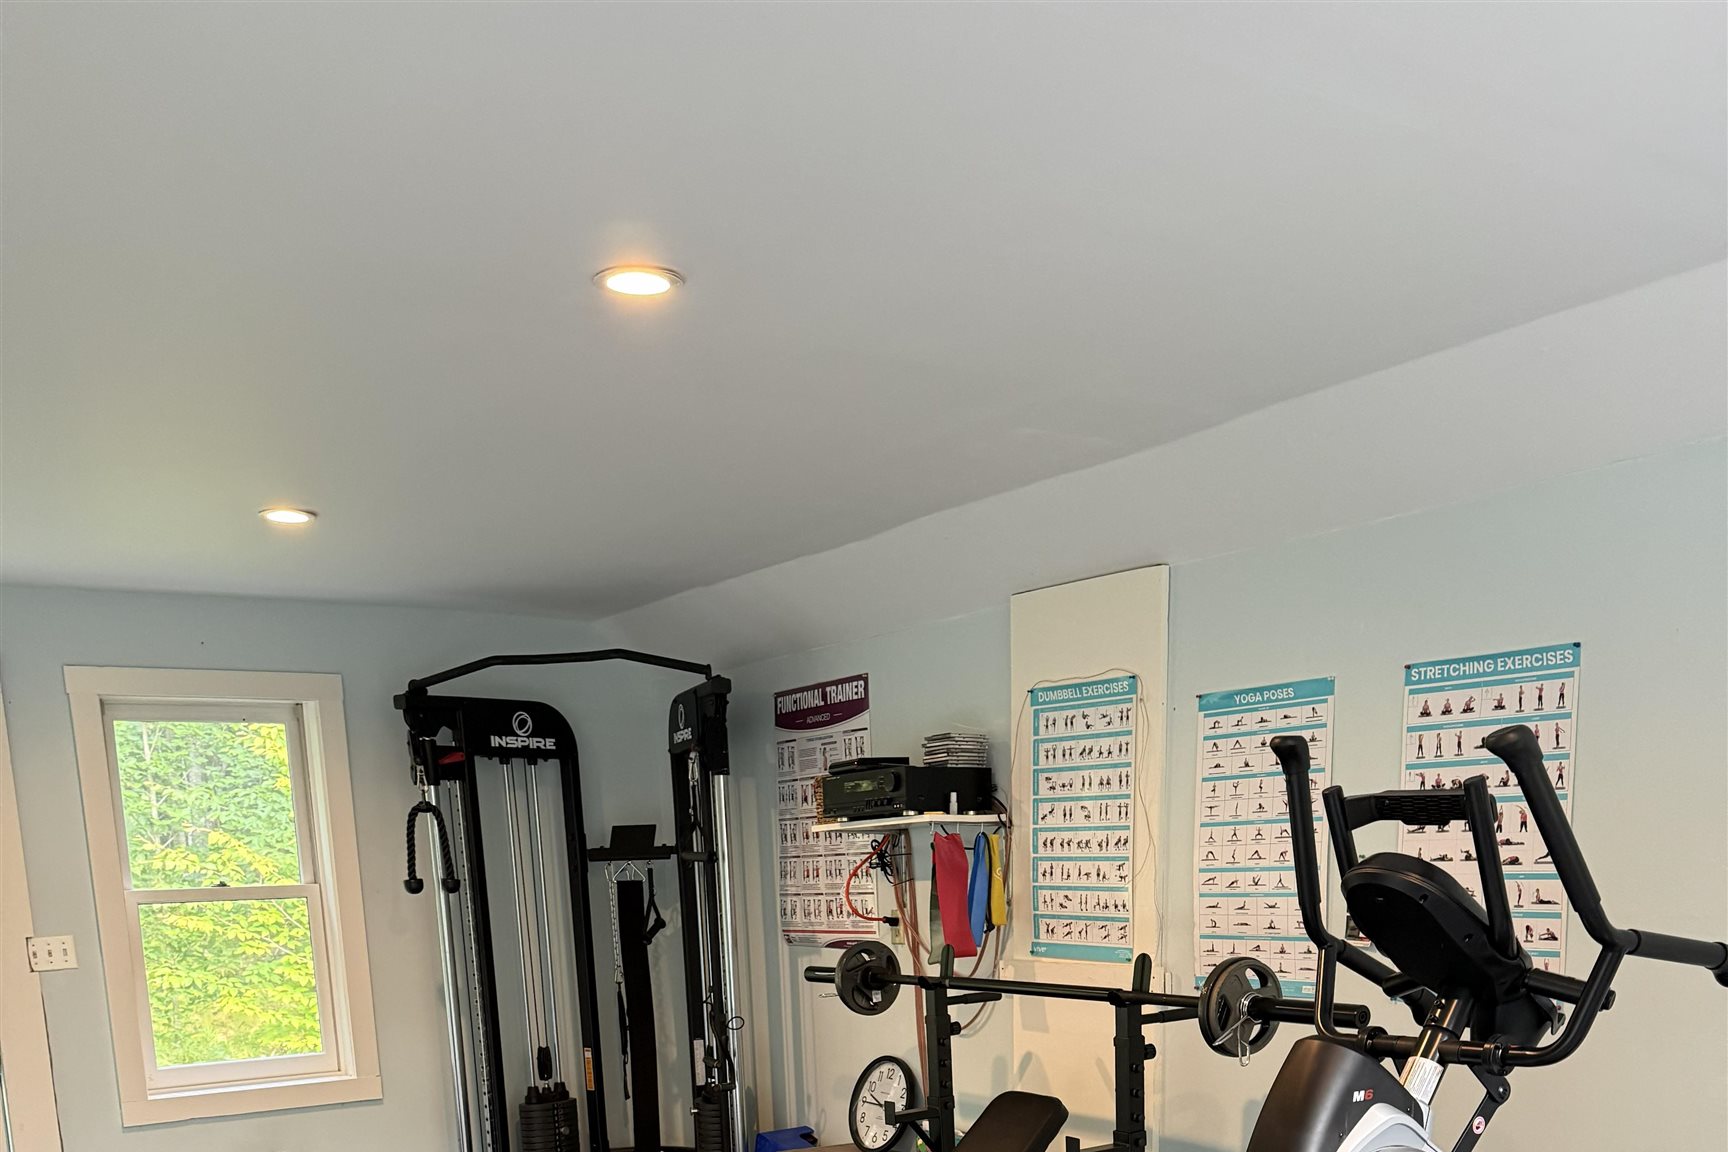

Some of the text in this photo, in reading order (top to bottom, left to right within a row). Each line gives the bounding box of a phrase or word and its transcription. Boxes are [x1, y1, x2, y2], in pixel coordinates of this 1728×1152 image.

[1411, 649, 1574, 681] STRETCHING EXERCISES
[777, 680, 865, 715] FUNCTIONAL TRAINER
[1038, 681, 1129, 702] DUMBBELL EXERCISES
[1234, 687, 1295, 705] YOGA POSES
[806, 712, 831, 724] ADVANCED
[490, 735, 556, 749] INSPIRE
[877, 1070, 884, 1082] 11
[886, 1068, 895, 1080] 12
[897, 1074, 902, 1086] 1
[868, 1081, 876, 1092] 10
[900, 1087, 907, 1099] 2
[1352, 1088, 1374, 1103] M6
[861, 1096, 867, 1107] 9
[860, 1112, 866, 1123] 8
[864, 1125, 870, 1137] 7
[882, 1130, 889, 1141] 5
[871, 1132, 878, 1143] 6
